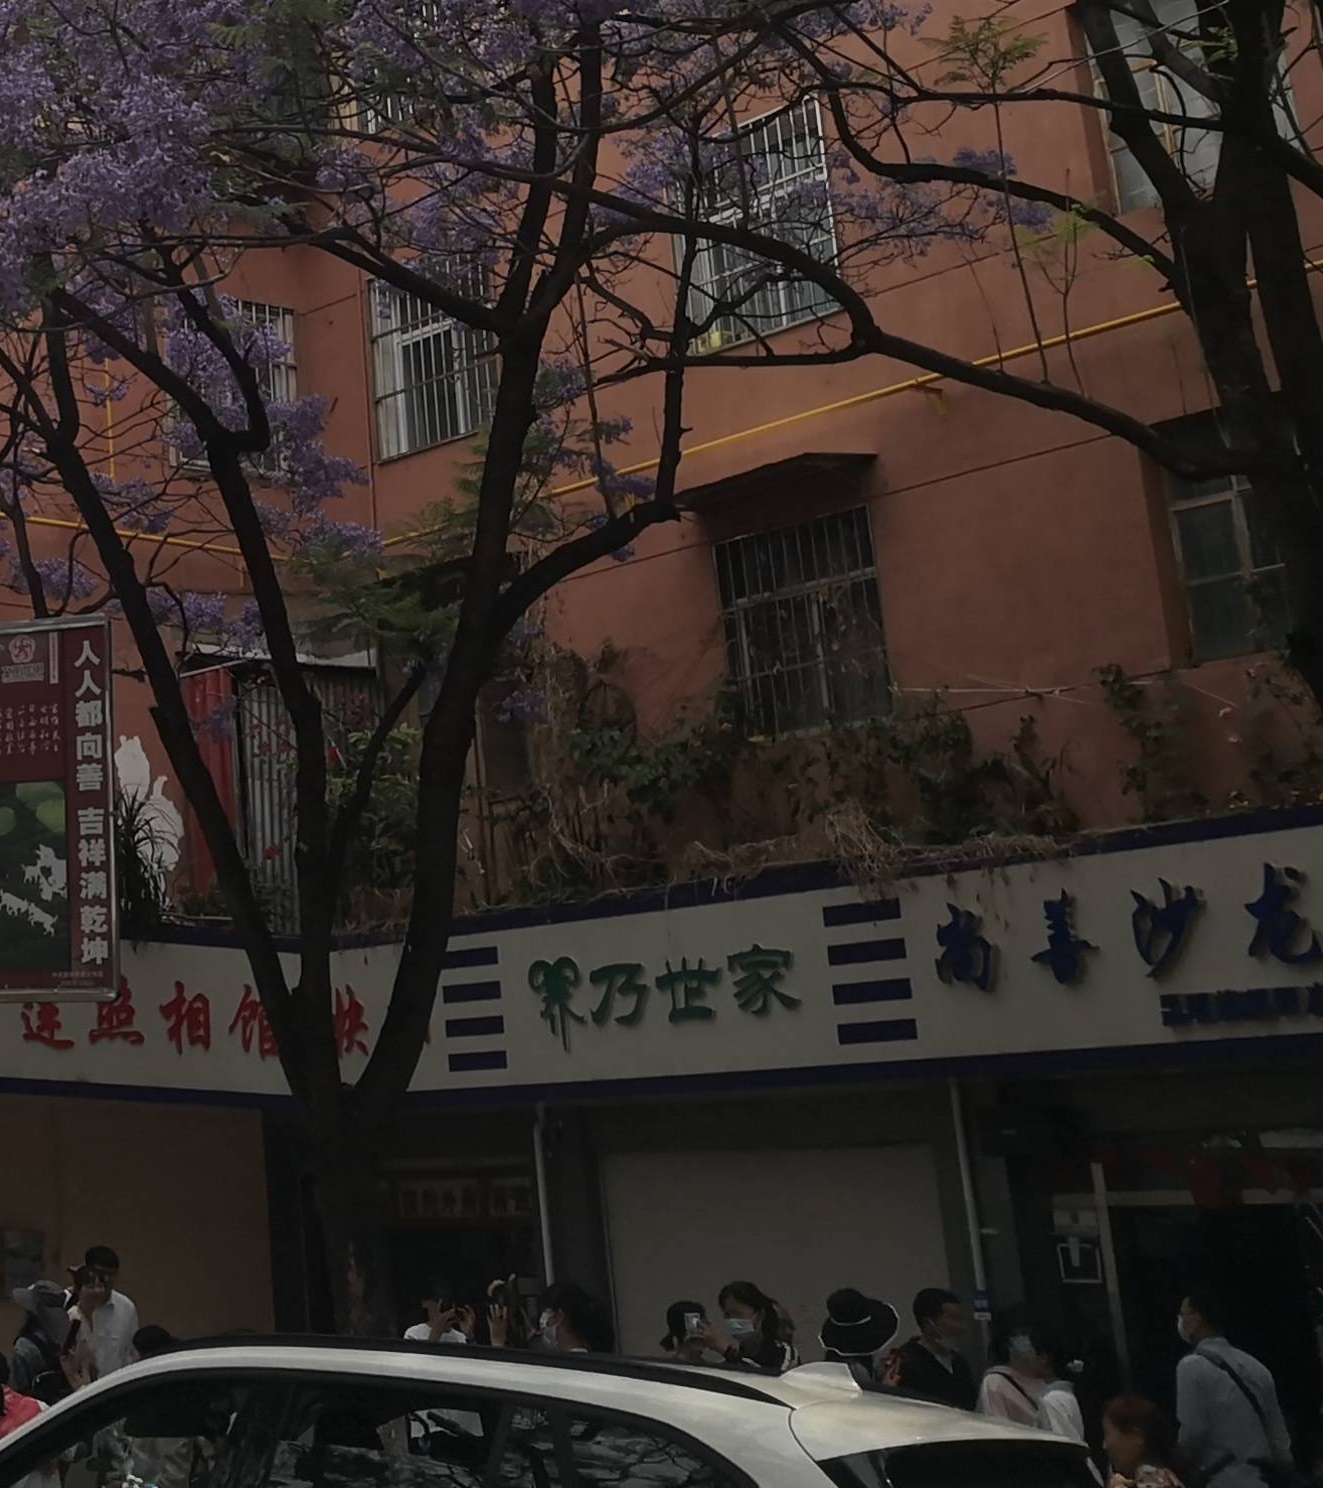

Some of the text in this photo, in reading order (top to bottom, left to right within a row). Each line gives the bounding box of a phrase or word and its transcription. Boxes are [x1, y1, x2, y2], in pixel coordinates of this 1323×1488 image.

[73, 639, 105, 792] 人人都向善
[76, 807, 110, 968] 吉祥满乾坤
